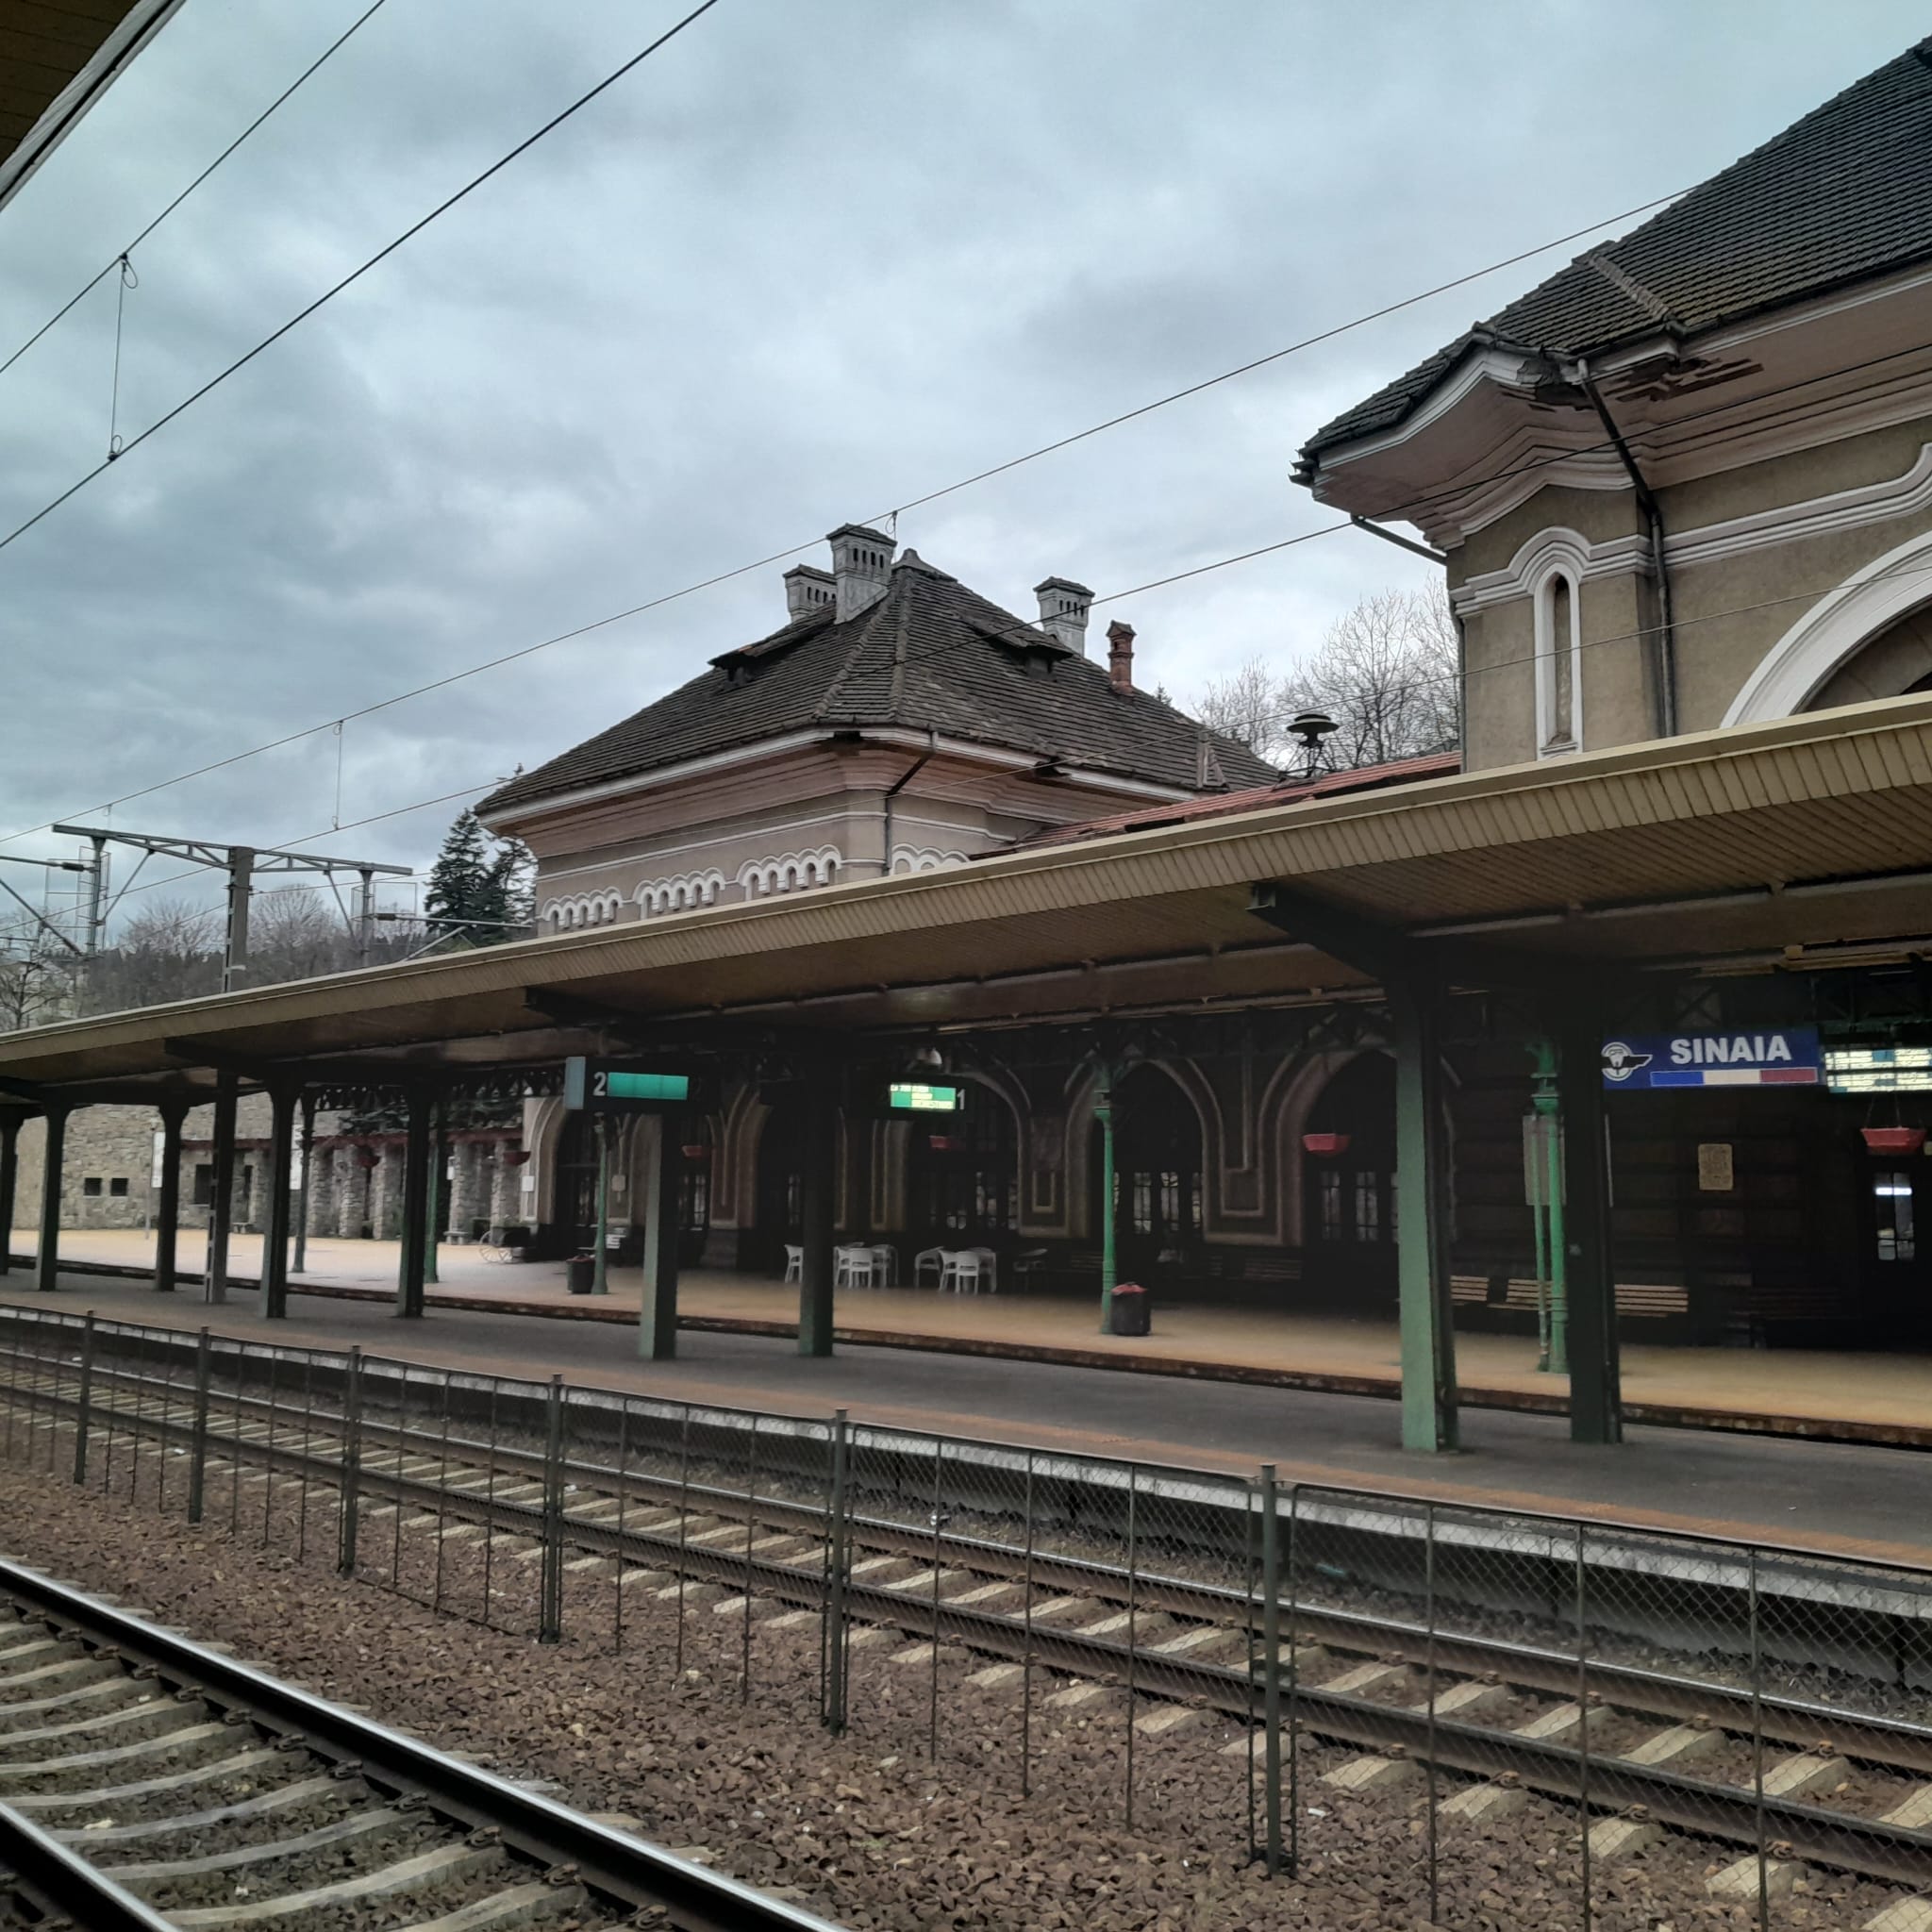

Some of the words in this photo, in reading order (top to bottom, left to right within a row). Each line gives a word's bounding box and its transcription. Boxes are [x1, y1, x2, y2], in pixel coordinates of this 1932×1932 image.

[1671, 1036, 1791, 1064] SINAIA
[593, 1072, 607, 1096] 2
[957, 1088, 966, 1110] 1
